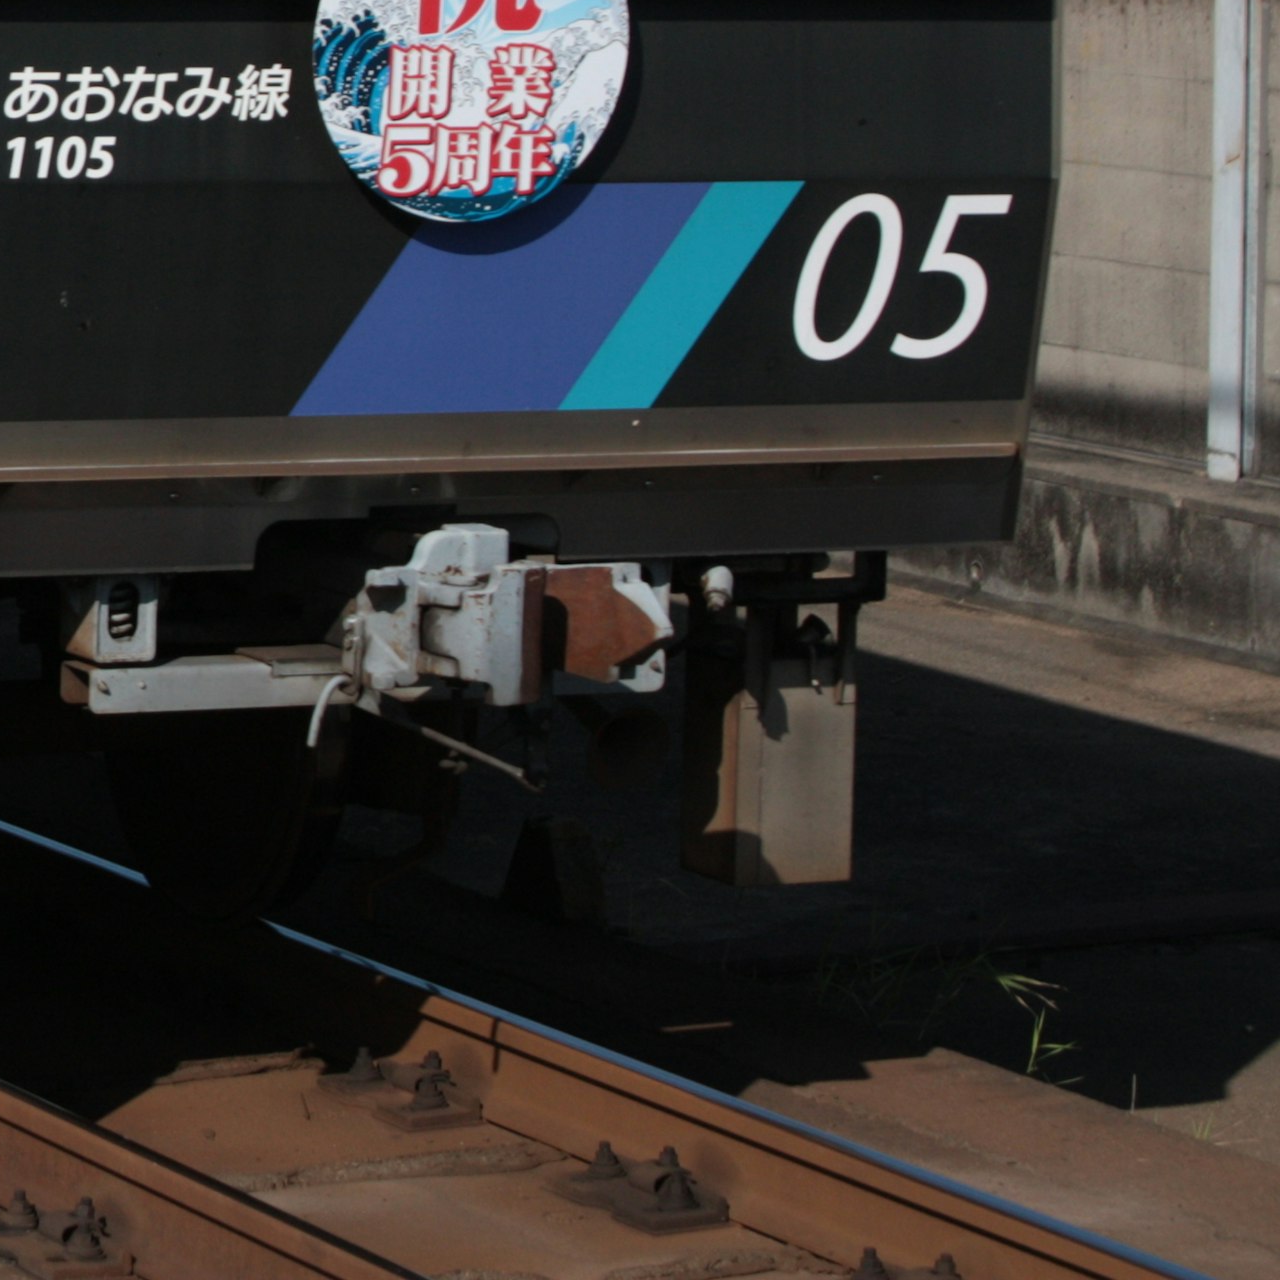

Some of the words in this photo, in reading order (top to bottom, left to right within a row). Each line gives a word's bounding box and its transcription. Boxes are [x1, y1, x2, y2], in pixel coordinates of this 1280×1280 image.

[3, 63, 293, 122] あおなみ線
[388, 42, 557, 120] 開業
[5, 136, 117, 179] 1105
[376, 121, 558, 198] 5周年
[792, 192, 1014, 362] 05
